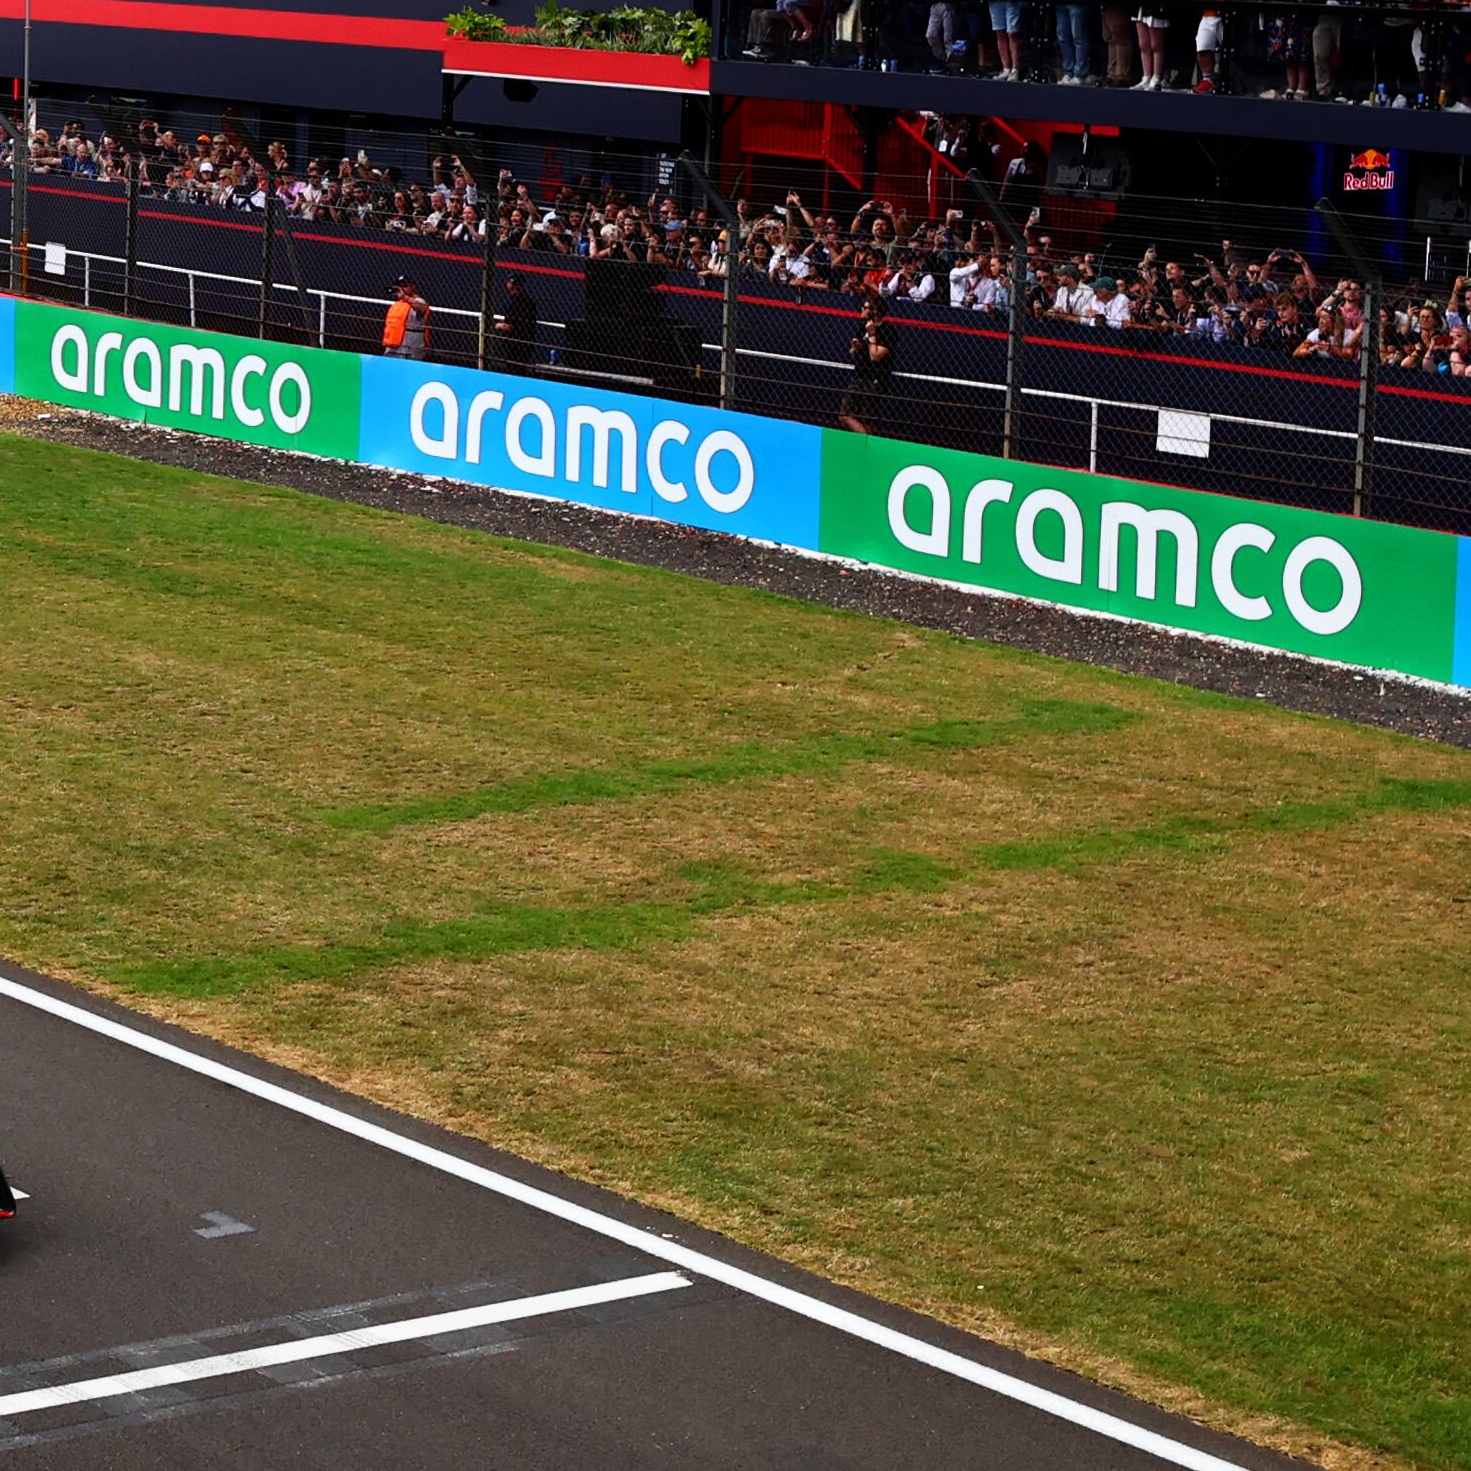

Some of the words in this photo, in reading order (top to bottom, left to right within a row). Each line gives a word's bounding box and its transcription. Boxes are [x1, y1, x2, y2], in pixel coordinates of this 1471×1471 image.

[1343, 172, 1369, 191] Red
[1369, 171, 1395, 190] Bull
[51, 324, 311, 434] aramco
[410, 381, 754, 513] aramco
[887, 465, 1362, 635] aramco
